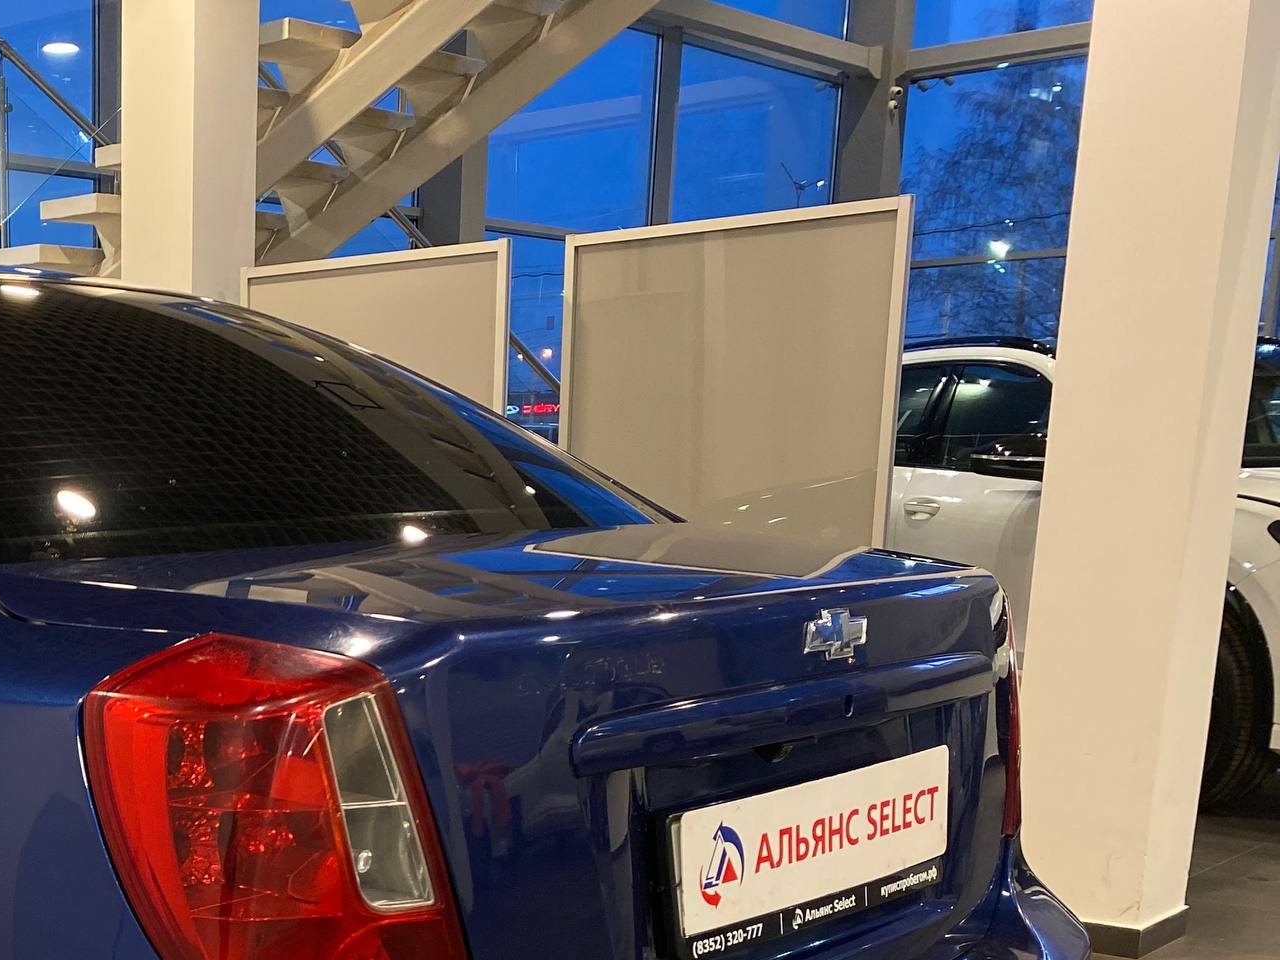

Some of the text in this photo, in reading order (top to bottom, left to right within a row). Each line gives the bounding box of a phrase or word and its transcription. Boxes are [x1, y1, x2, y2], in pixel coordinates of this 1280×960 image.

[754, 786, 939, 874] АЛЬЯНС SELECT
[805, 894, 856, 922] Альянс Select
[692, 923, 763, 959] (8352) 320-777
